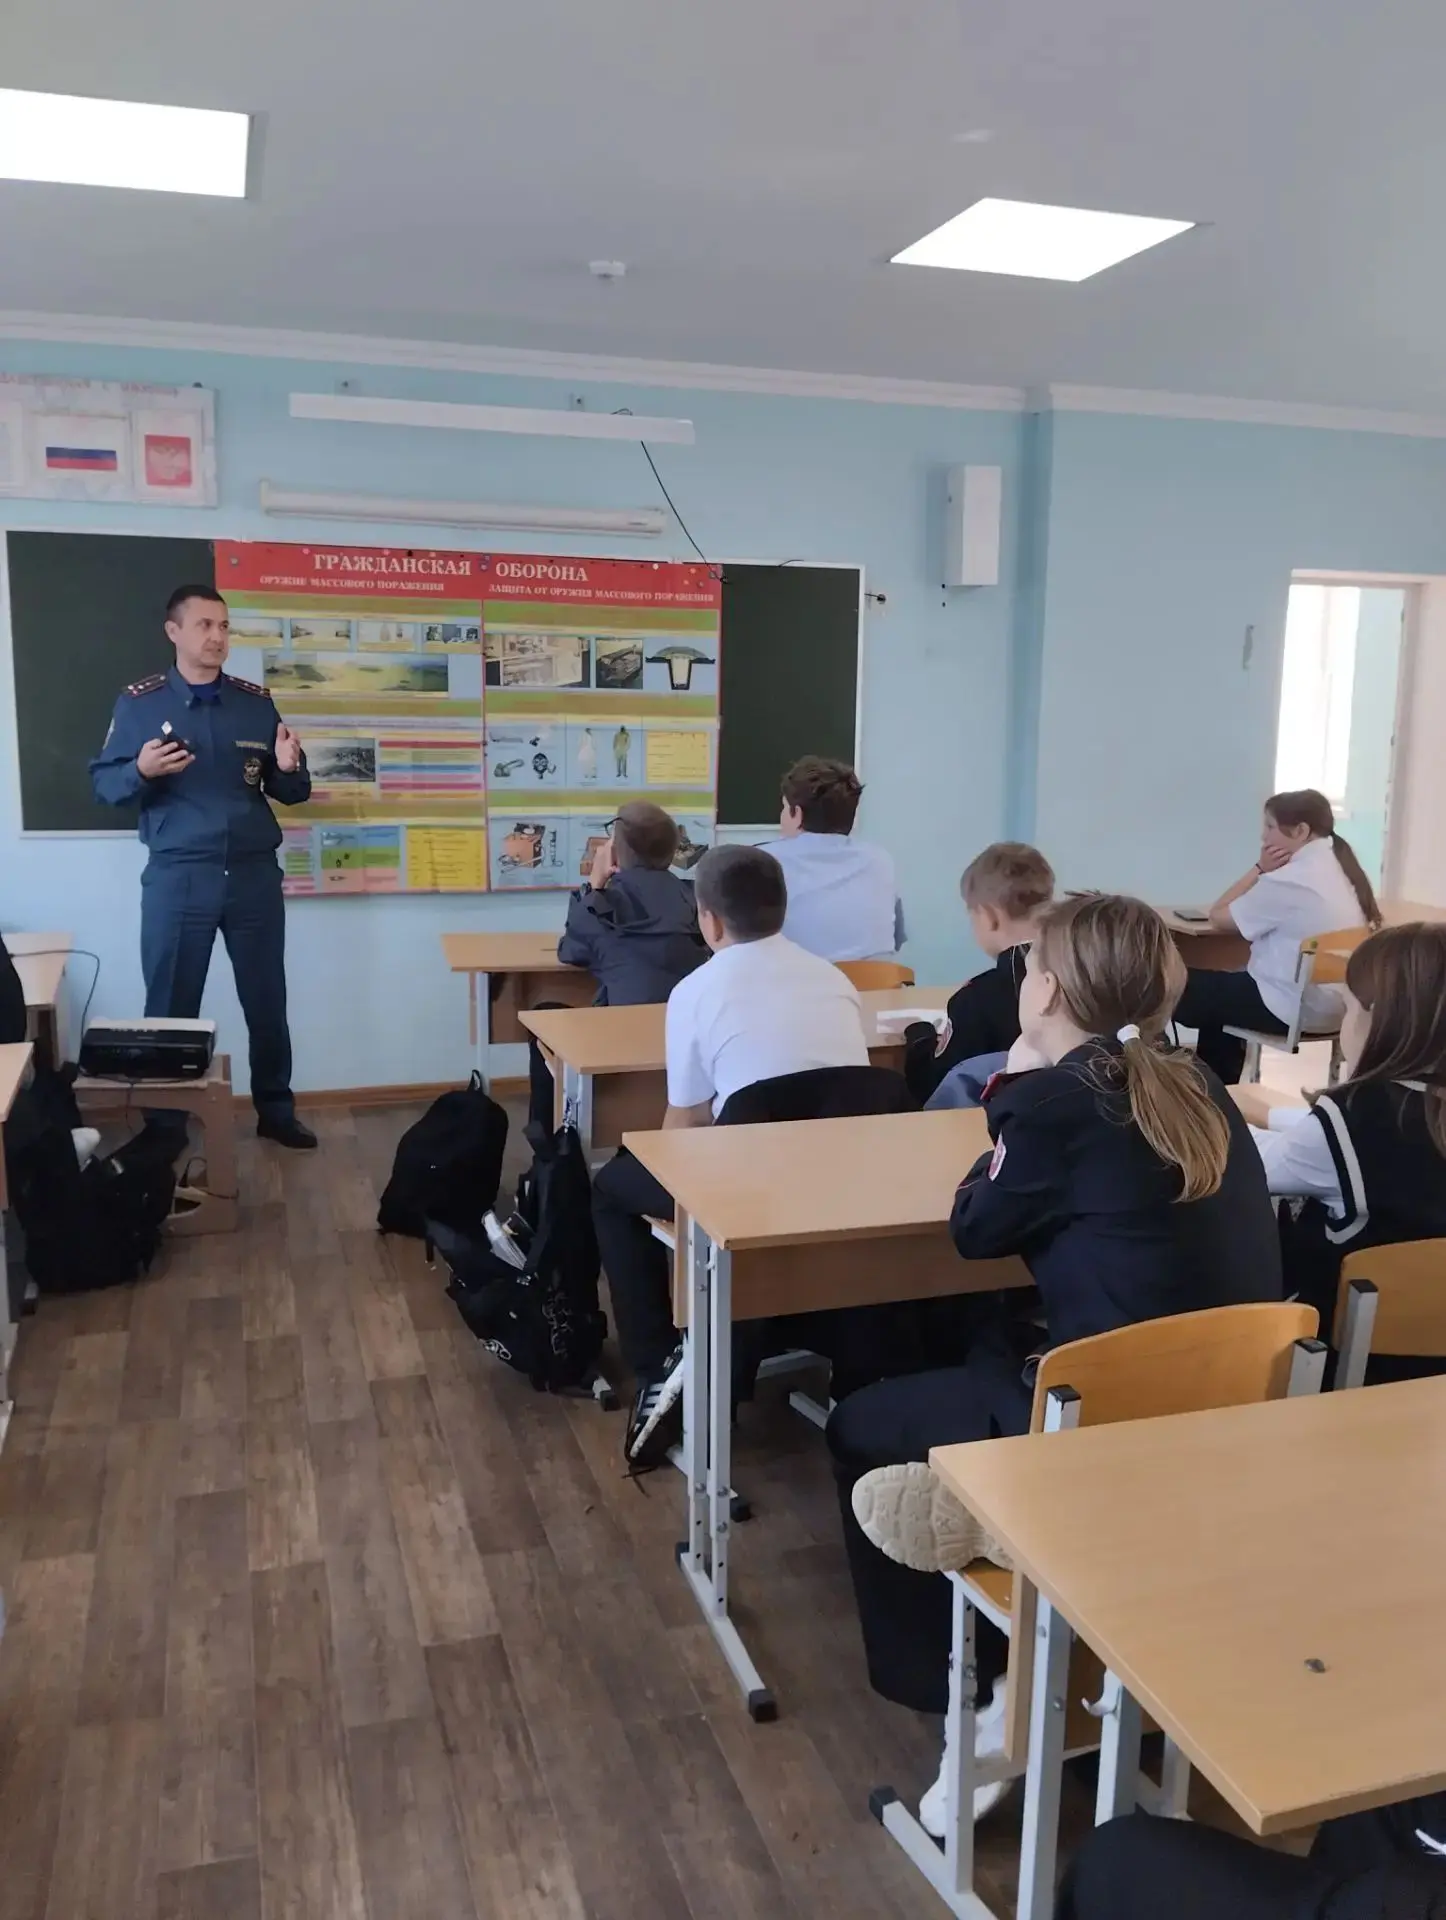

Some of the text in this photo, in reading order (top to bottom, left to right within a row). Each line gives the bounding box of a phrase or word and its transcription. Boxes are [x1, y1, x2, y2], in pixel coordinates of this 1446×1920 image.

[314, 554, 589, 582] ГРАЖДАНСКАЯ ОБОРОНА
[260, 575, 445, 591] ОРУЖИЕ МАССОВОГО ПОРАЖЕНИЯ
[489, 584, 532, 595] ЗАЩИТА
[534, 586, 548, 596] ОТ
[595, 589, 652, 601] МАССОВОГО
